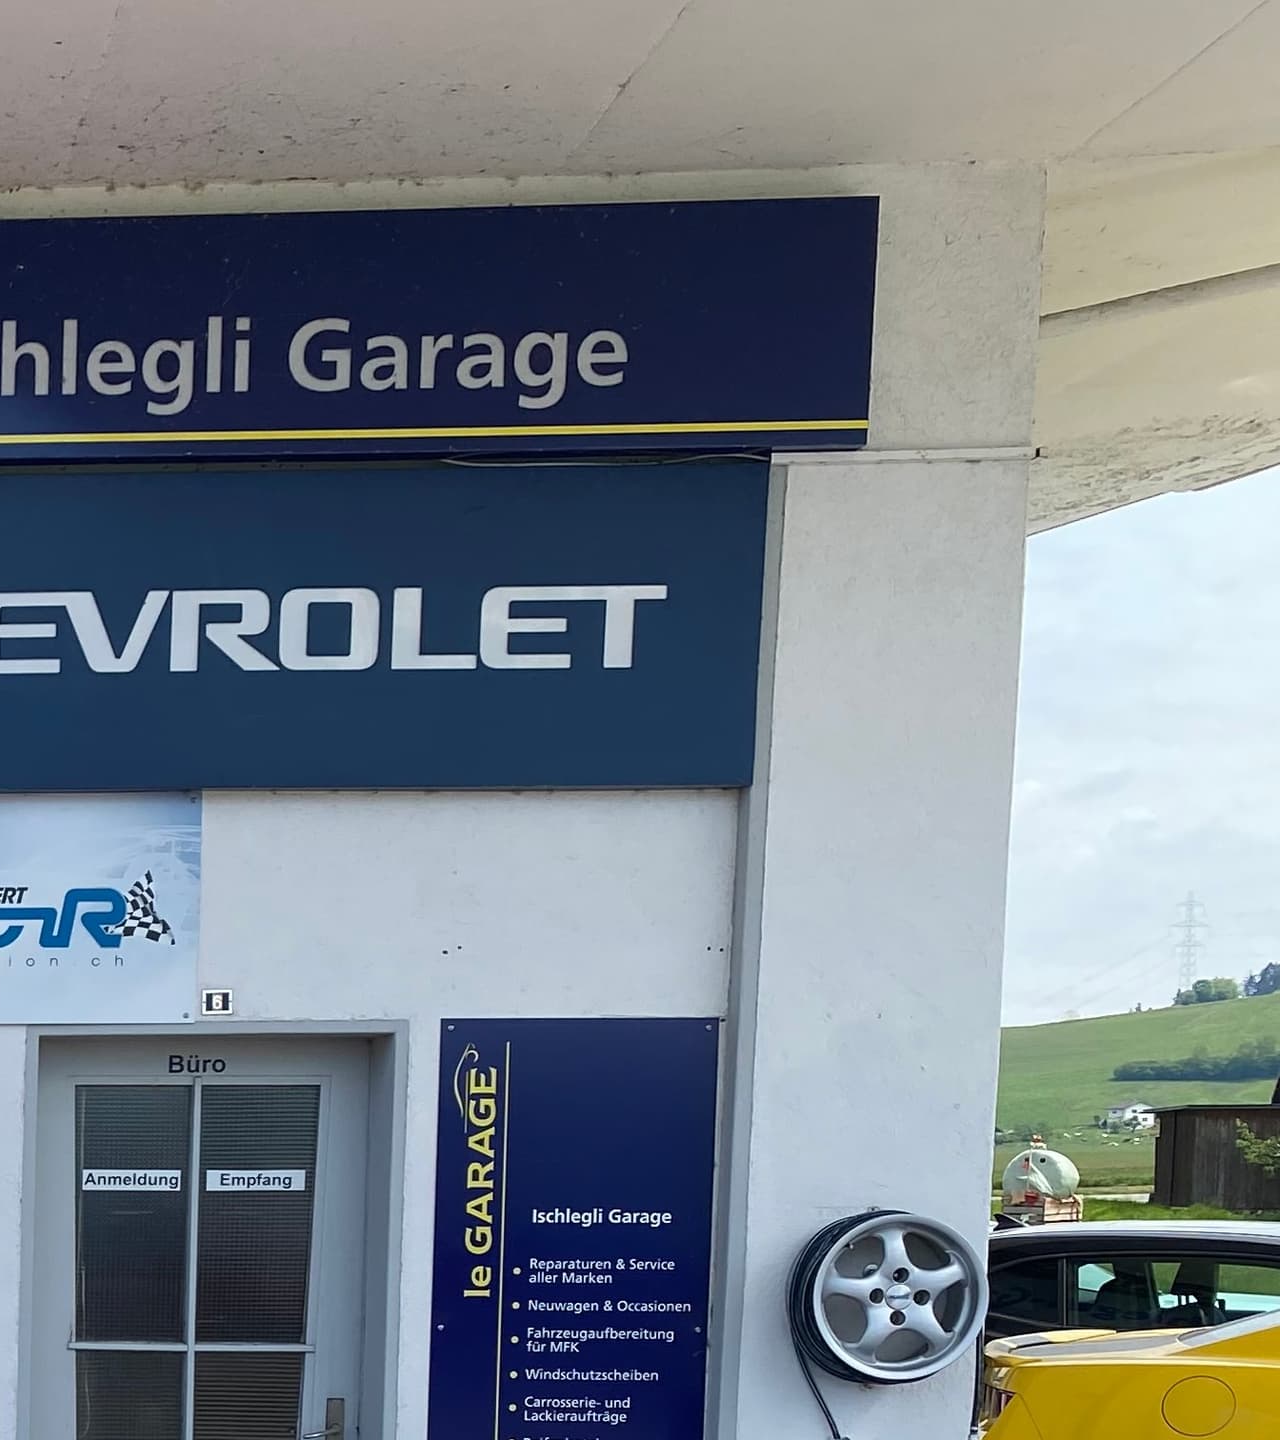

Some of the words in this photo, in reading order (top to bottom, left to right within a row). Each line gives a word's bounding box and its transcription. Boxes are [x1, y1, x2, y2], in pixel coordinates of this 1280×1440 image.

[289, 317, 630, 409] Garage
[212, 994, 223, 1010] 6
[167, 1054, 226, 1074] Büro
[464, 1065, 498, 1256] GARAGE
[84, 1172, 179, 1190] Anmeldung
[220, 1172, 293, 1190] Empfang
[531, 1207, 604, 1227] Ischlegli
[608, 1208, 673, 1227] Garage
[529, 1258, 611, 1273] Reparaturen
[615, 1258, 626, 1270] &
[629, 1258, 676, 1271] Service
[463, 1265, 492, 1298] le
[528, 1272, 558, 1284] aller
[562, 1272, 613, 1284] Marken
[528, 1300, 599, 1315] Neuwagen
[603, 1300, 613, 1312] &
[617, 1300, 692, 1313] Occasionen
[527, 1327, 675, 1343] Fahrzeugaufbereitung
[526, 1341, 546, 1354] für
[550, 1341, 580, 1354] MFK
[525, 1368, 659, 1382] Windschutzscheiben
[524, 1396, 601, 1409] Carrosserie-
[604, 1396, 631, 1409] und
[523, 1410, 627, 1425] Lackieraufträge
